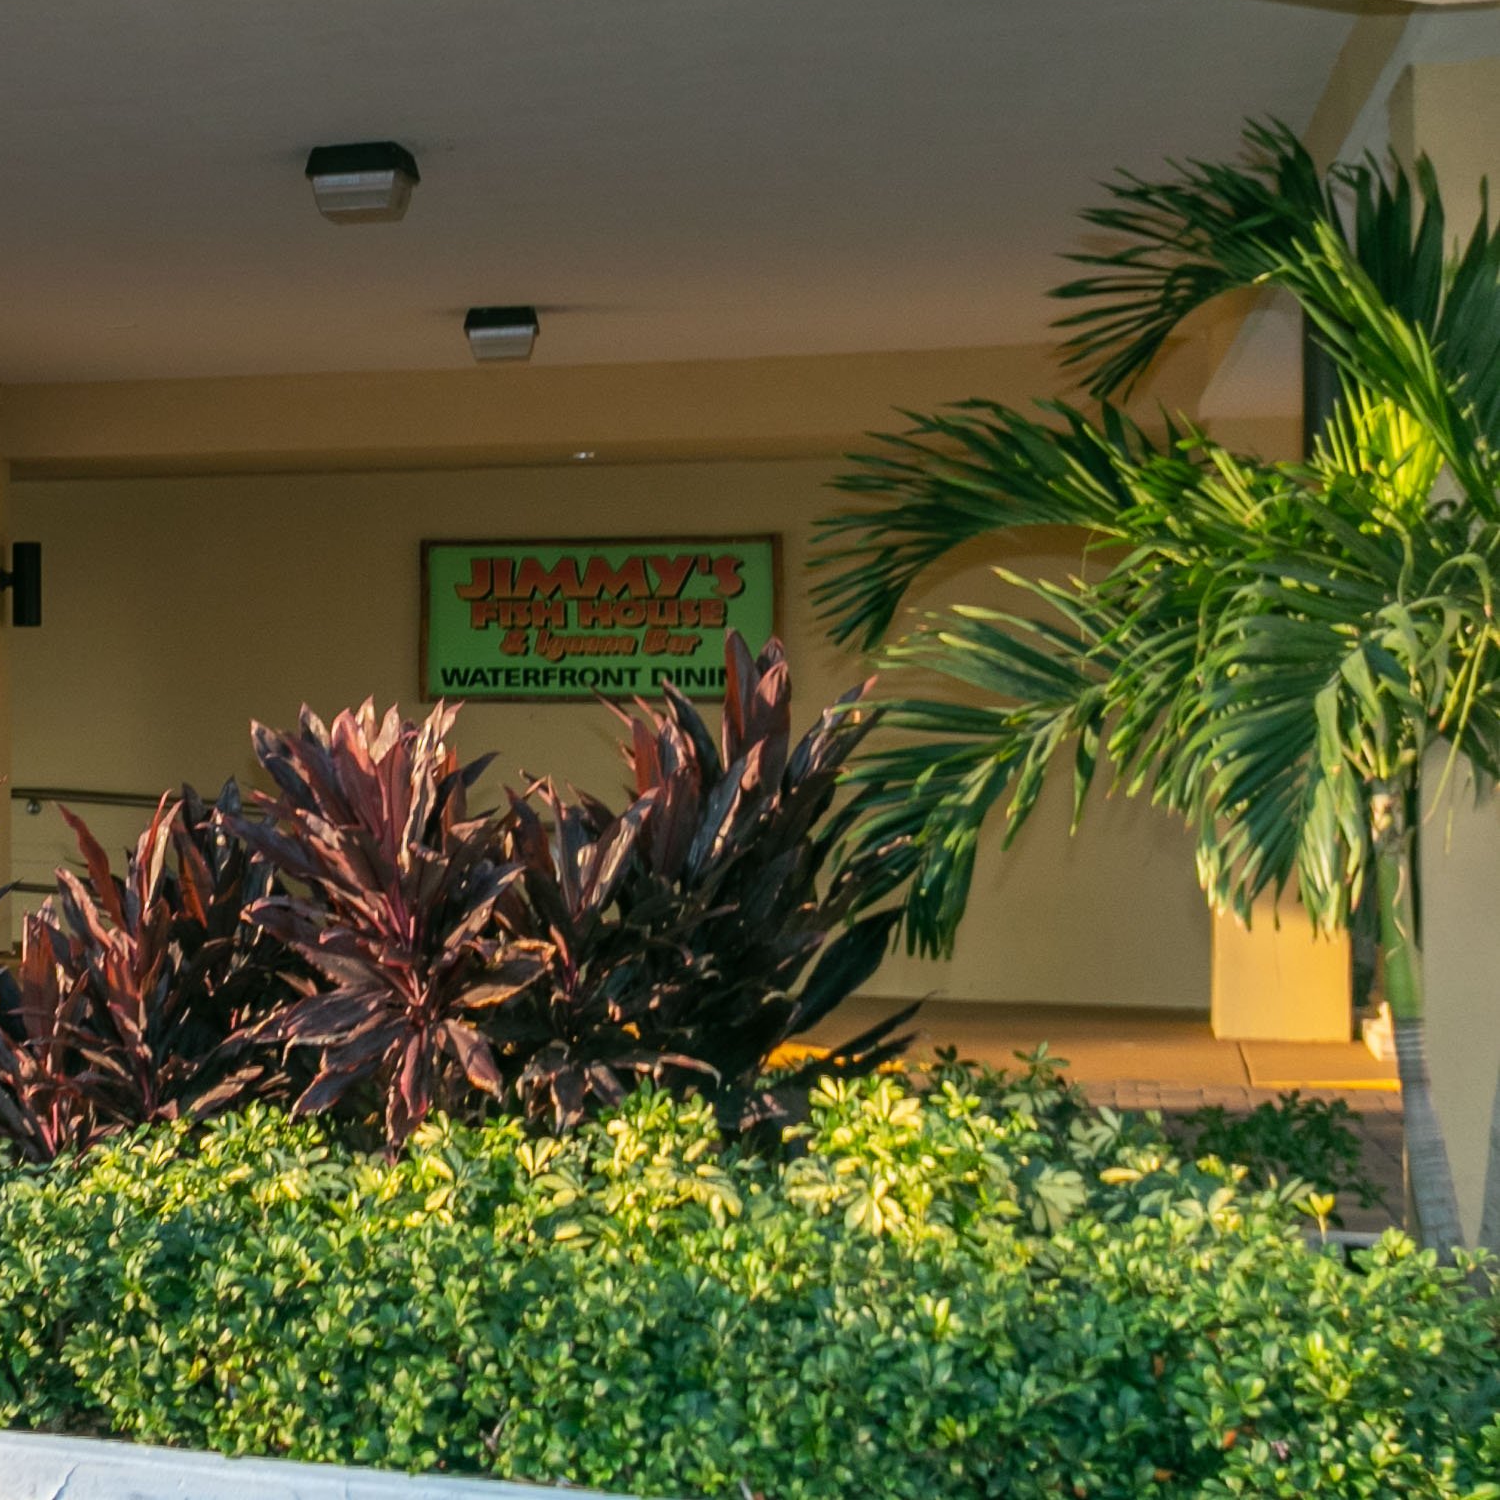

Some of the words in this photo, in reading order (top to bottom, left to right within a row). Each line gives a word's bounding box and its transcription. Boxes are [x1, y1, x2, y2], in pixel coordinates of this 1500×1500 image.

[454, 554, 745, 601] JIMMY'S
[470, 599, 568, 630] FISH
[577, 598, 728, 629] HOUSE
[500, 629, 529, 656] &
[534, 627, 639, 663] Iguana
[641, 626, 703, 656] Bar
[440, 666, 642, 688] WATERFRONT
